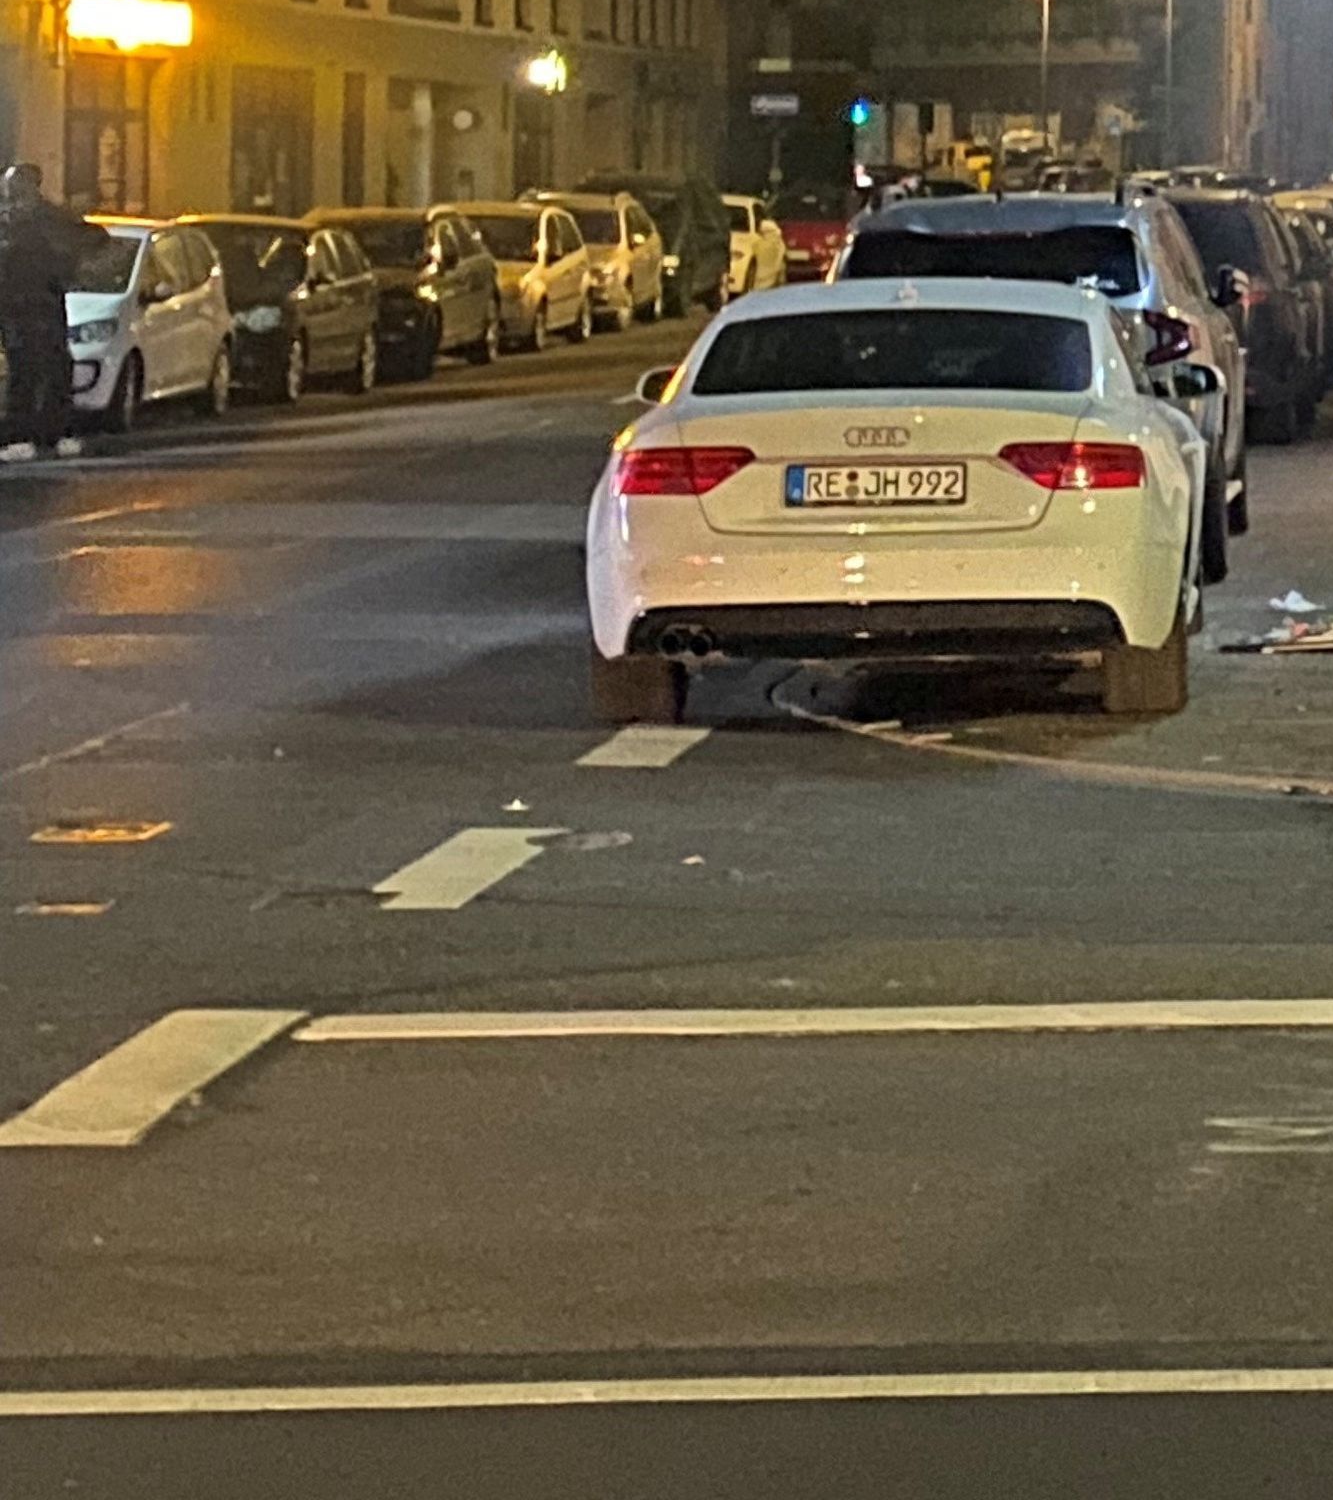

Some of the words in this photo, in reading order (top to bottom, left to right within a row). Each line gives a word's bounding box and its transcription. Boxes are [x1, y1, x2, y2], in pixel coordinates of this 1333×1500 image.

[807, 473, 842, 498] RE
[864, 471, 900, 497] JH
[908, 471, 959, 497] 992
